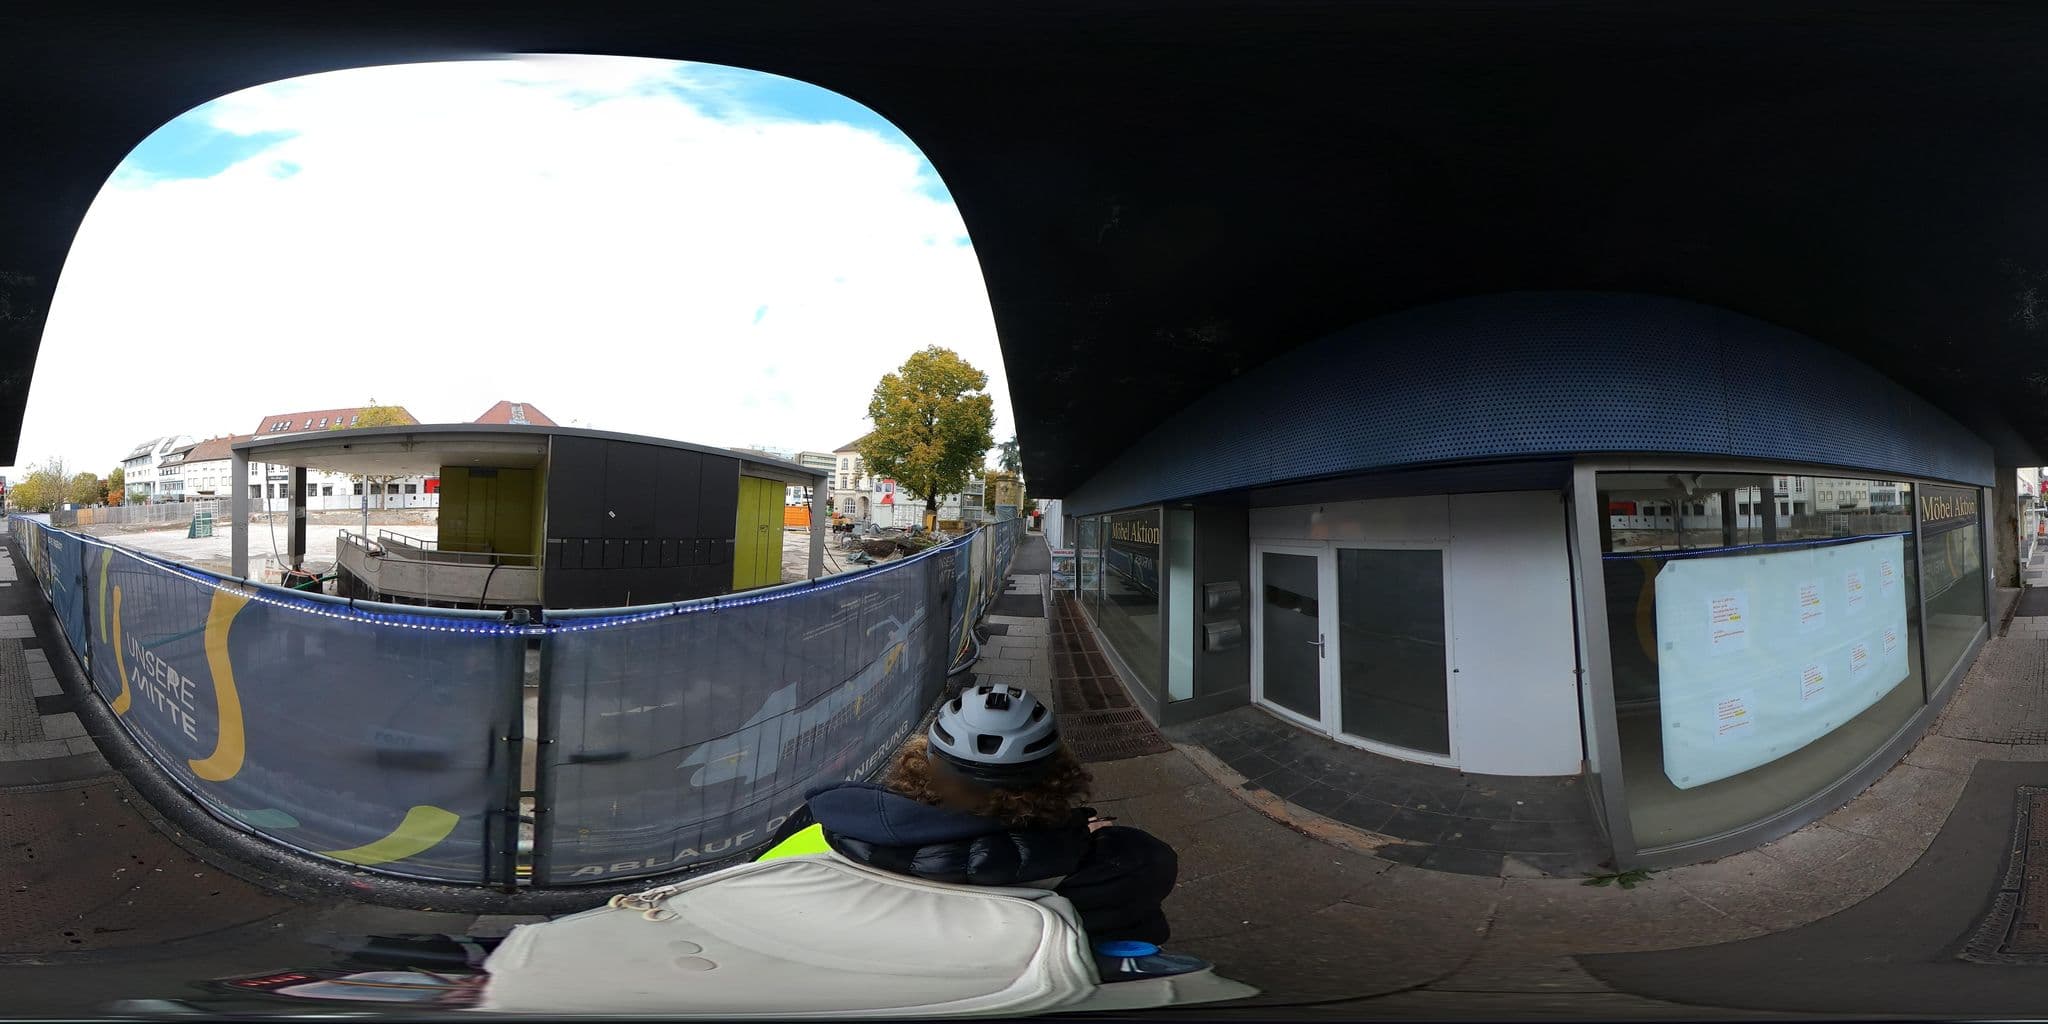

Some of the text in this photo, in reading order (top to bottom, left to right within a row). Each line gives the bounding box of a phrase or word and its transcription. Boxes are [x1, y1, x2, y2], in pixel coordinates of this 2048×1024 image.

[1131, 520, 1160, 545] Aktion
[1921, 496, 1976, 522] Möbel Aktion
[126, 632, 196, 711] UNSERE
[131, 667, 198, 742] MITTE
[571, 830, 755, 876] ABLAUF
[845, 720, 908, 782] ANIERUNG
